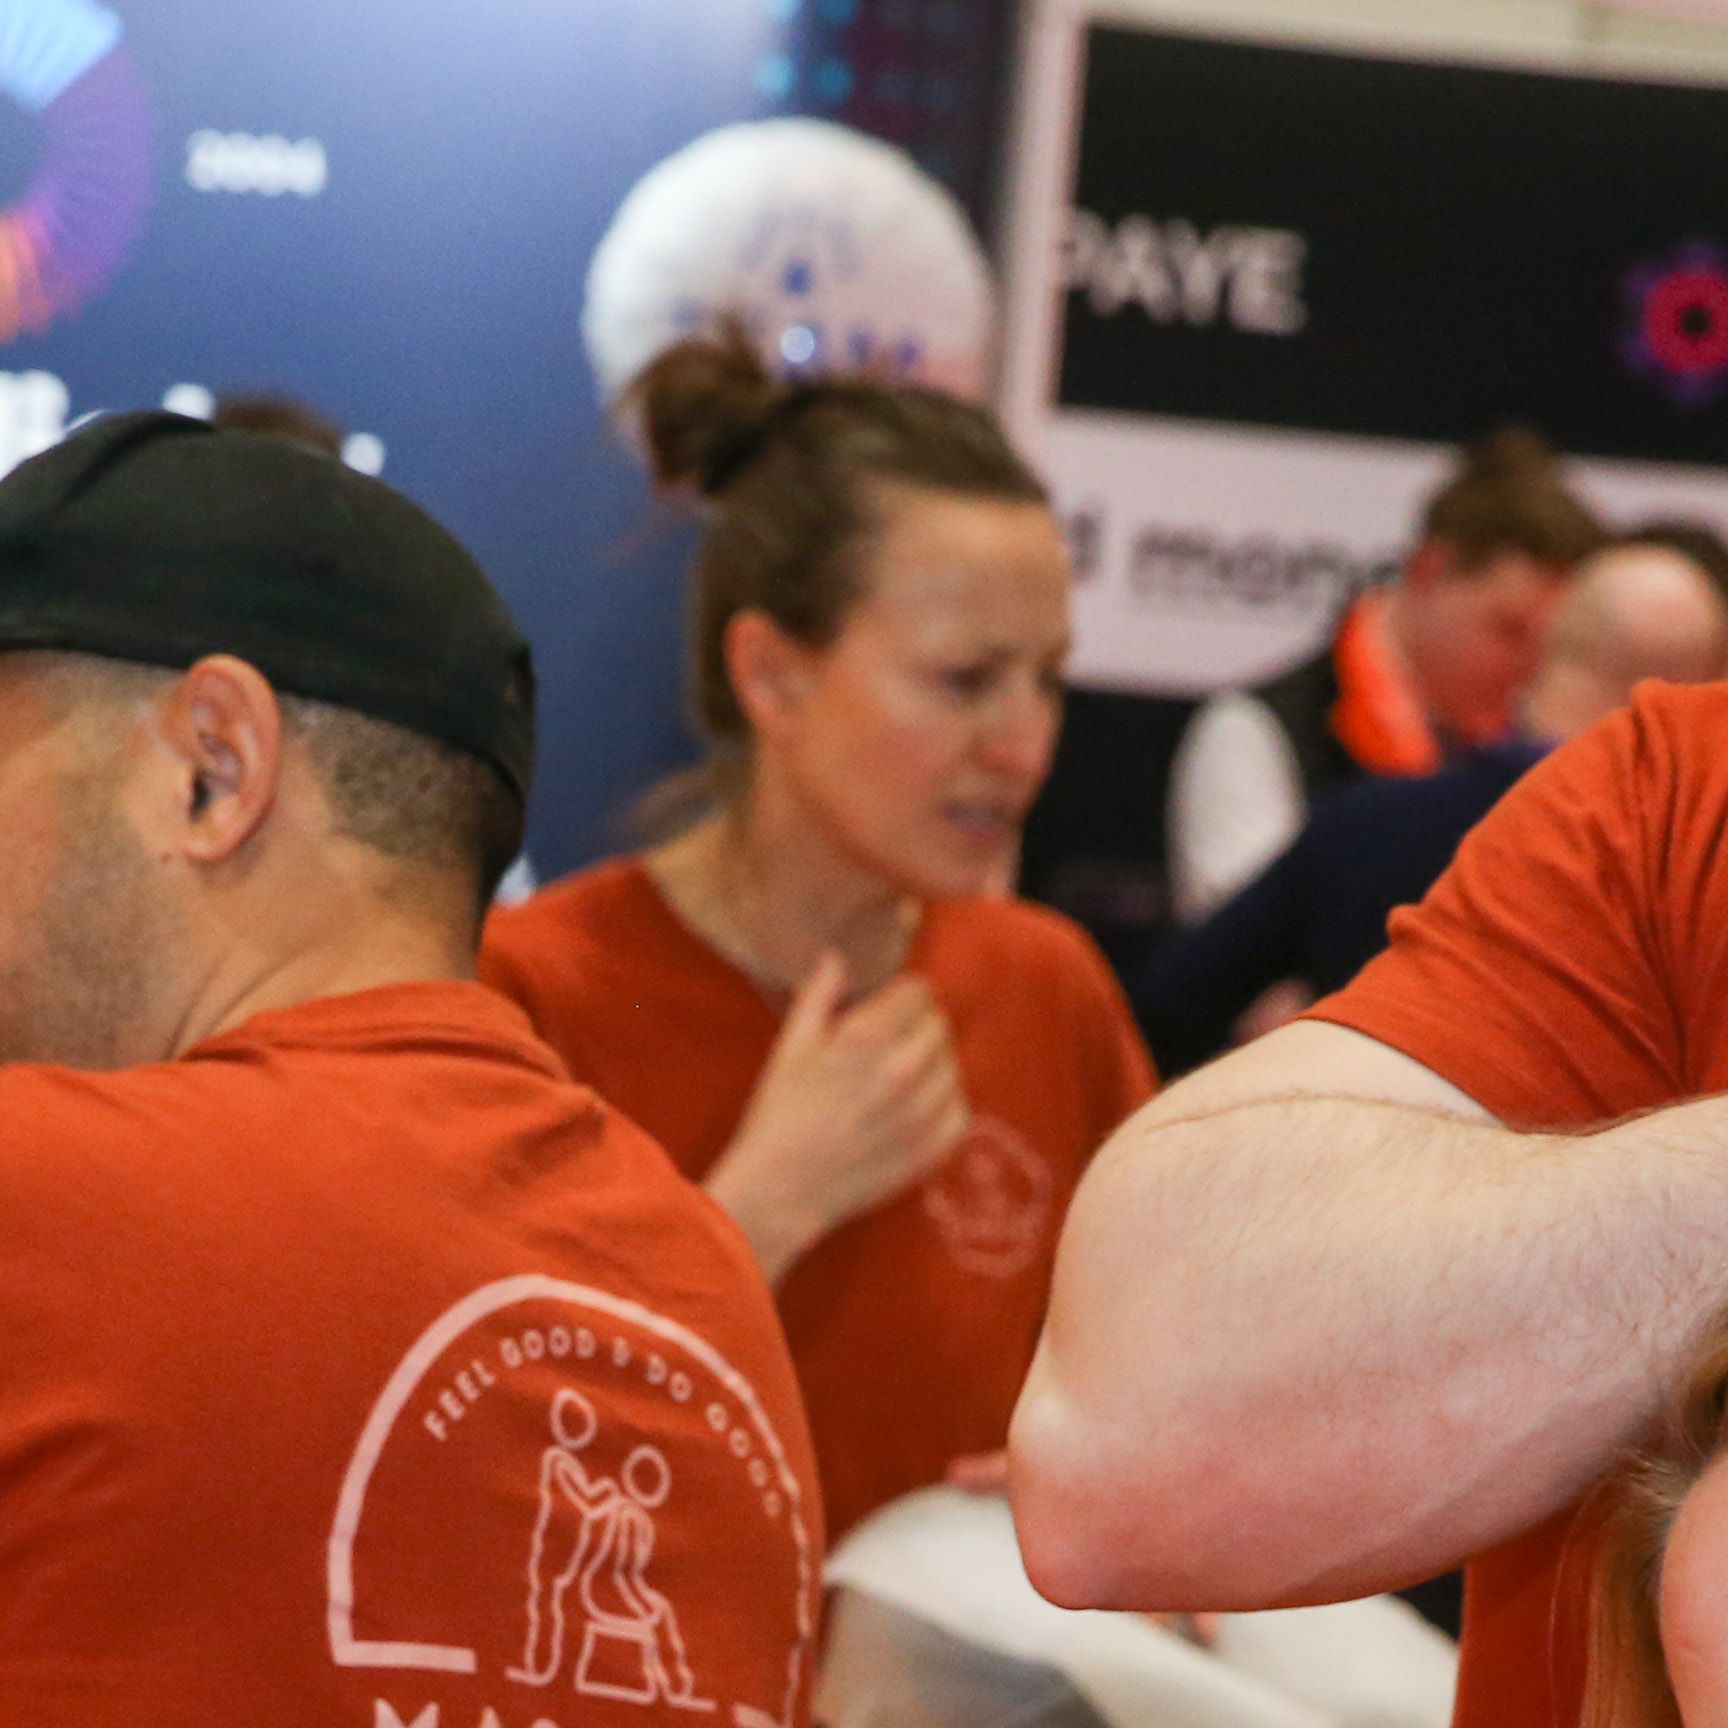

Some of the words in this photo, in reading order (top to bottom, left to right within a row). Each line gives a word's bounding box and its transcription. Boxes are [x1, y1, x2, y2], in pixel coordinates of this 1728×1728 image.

[424, 1358, 497, 1441] FEEL
[500, 1325, 597, 1368] GOOD
[646, 1352, 693, 1403] DO
